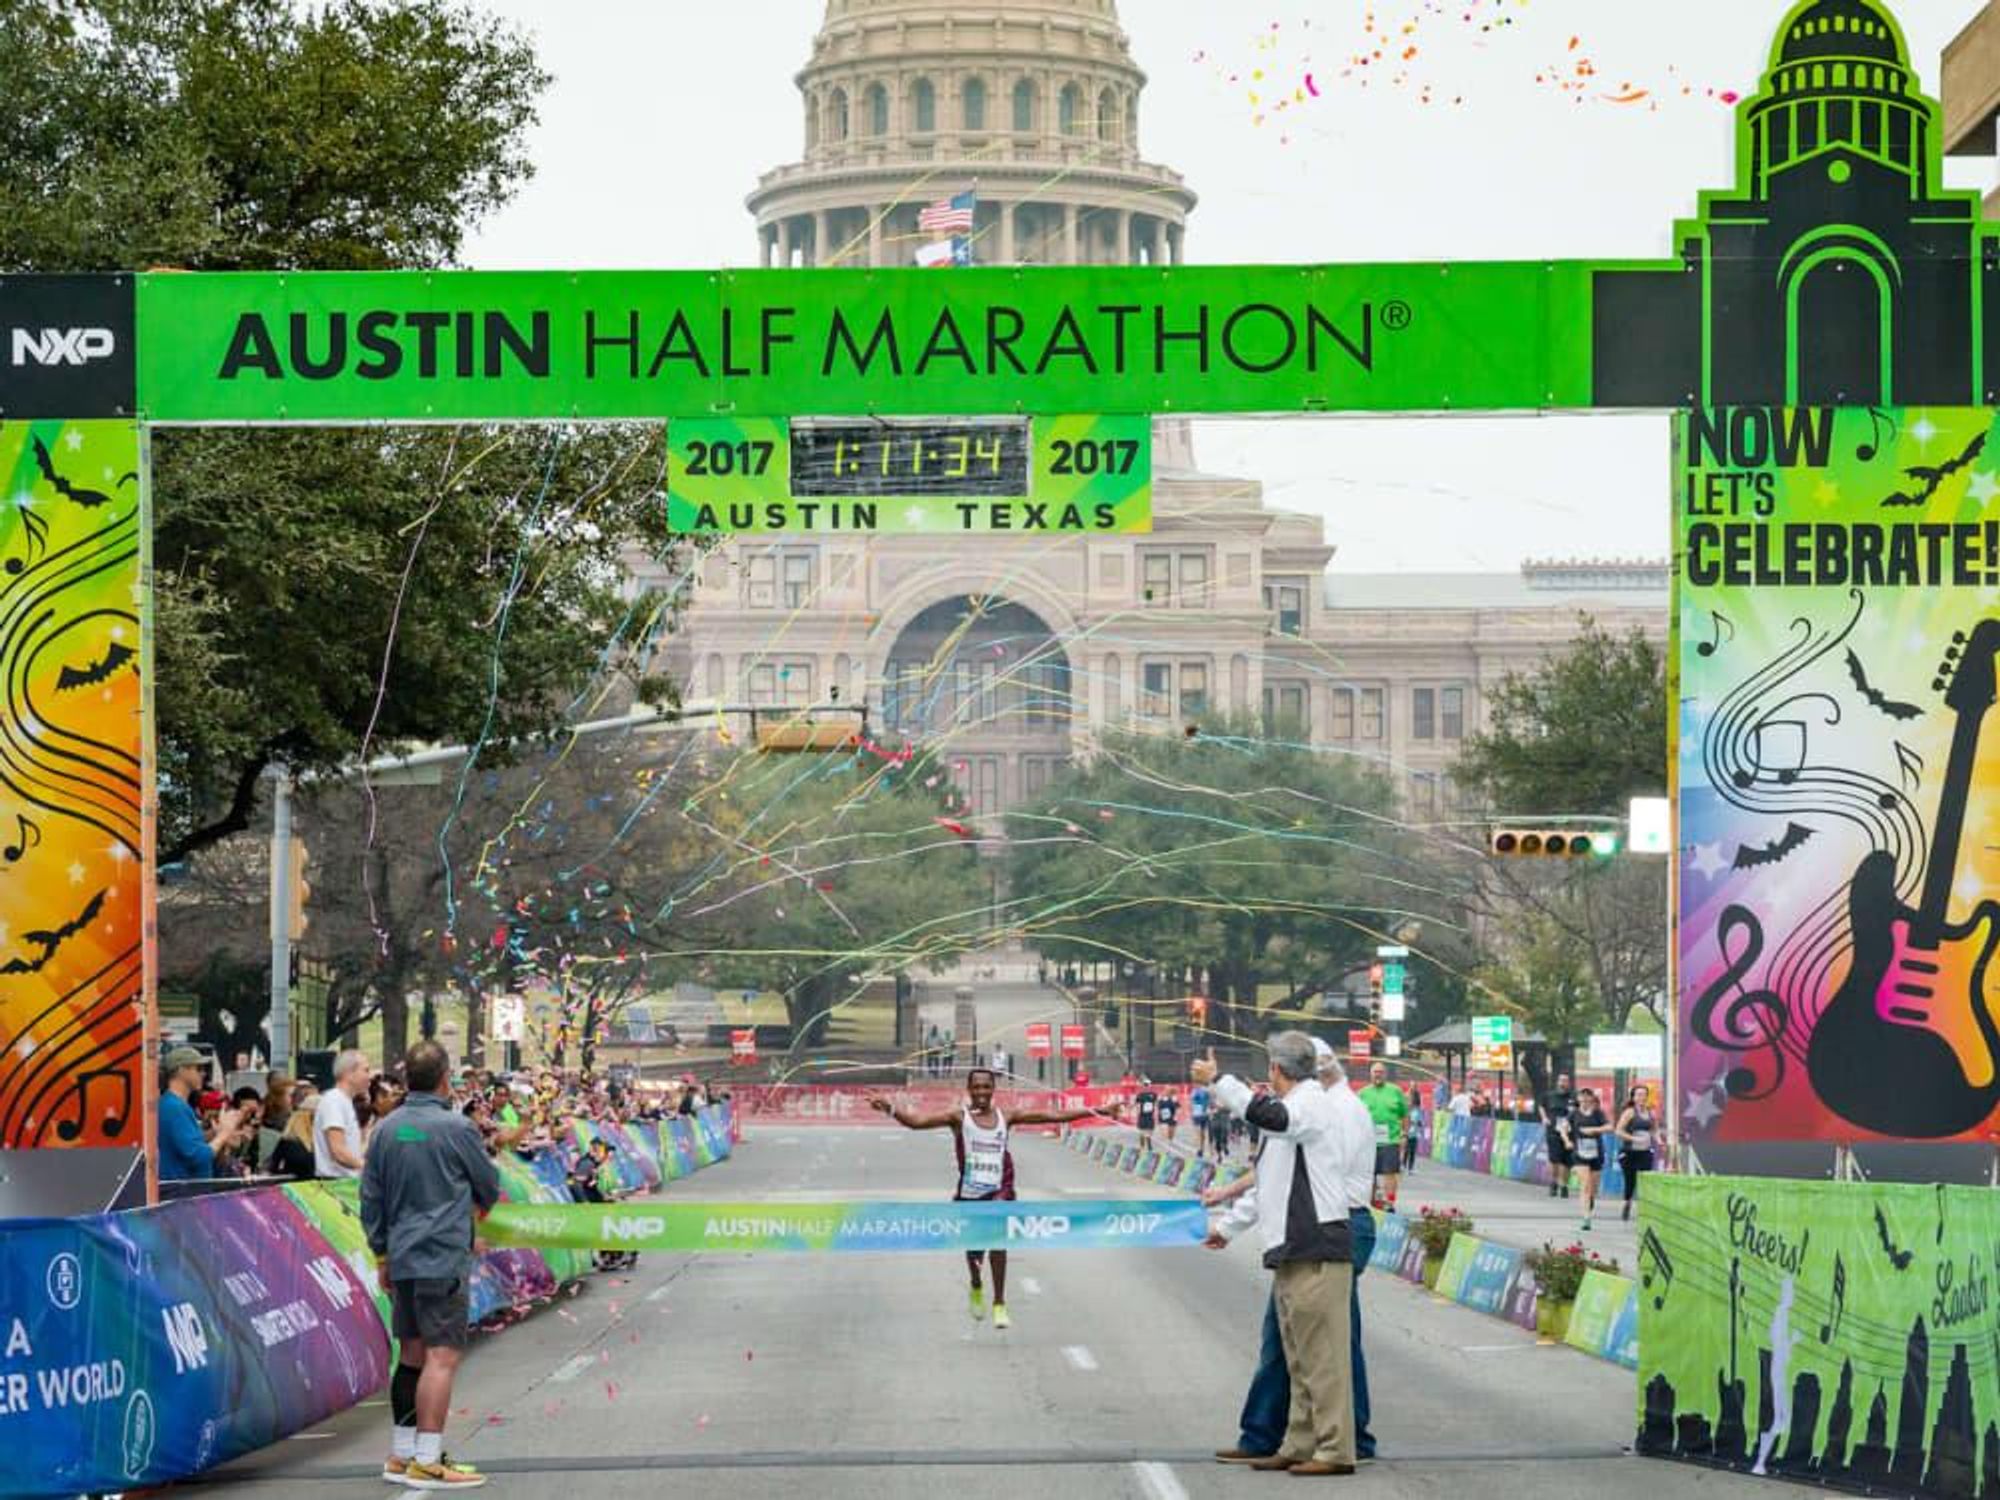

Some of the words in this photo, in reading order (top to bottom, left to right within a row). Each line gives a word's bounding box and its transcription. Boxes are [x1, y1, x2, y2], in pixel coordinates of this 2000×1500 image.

[12, 328, 114, 365] NXP
[218, 310, 550, 379] AUSTIN
[586, 307, 795, 378] HALF
[685, 440, 774, 476] 2017
[1049, 439, 1140, 475] 2017
[1687, 406, 1834, 467] NOW
[1686, 471, 1775, 516] LET'S
[694, 502, 878, 529] AUSTIN
[955, 502, 1116, 529] TEXAS
[1687, 520, 2000, 587] CELEBRATE!
[602, 1215, 666, 1241] NXP
[1007, 1215, 1071, 1240] NXP
[1106, 1213, 1163, 1235] 2017
[1727, 1191, 1810, 1276] Cheers!
[5, 1316, 32, 1358] A
[37, 1358, 125, 1409] WORLD
